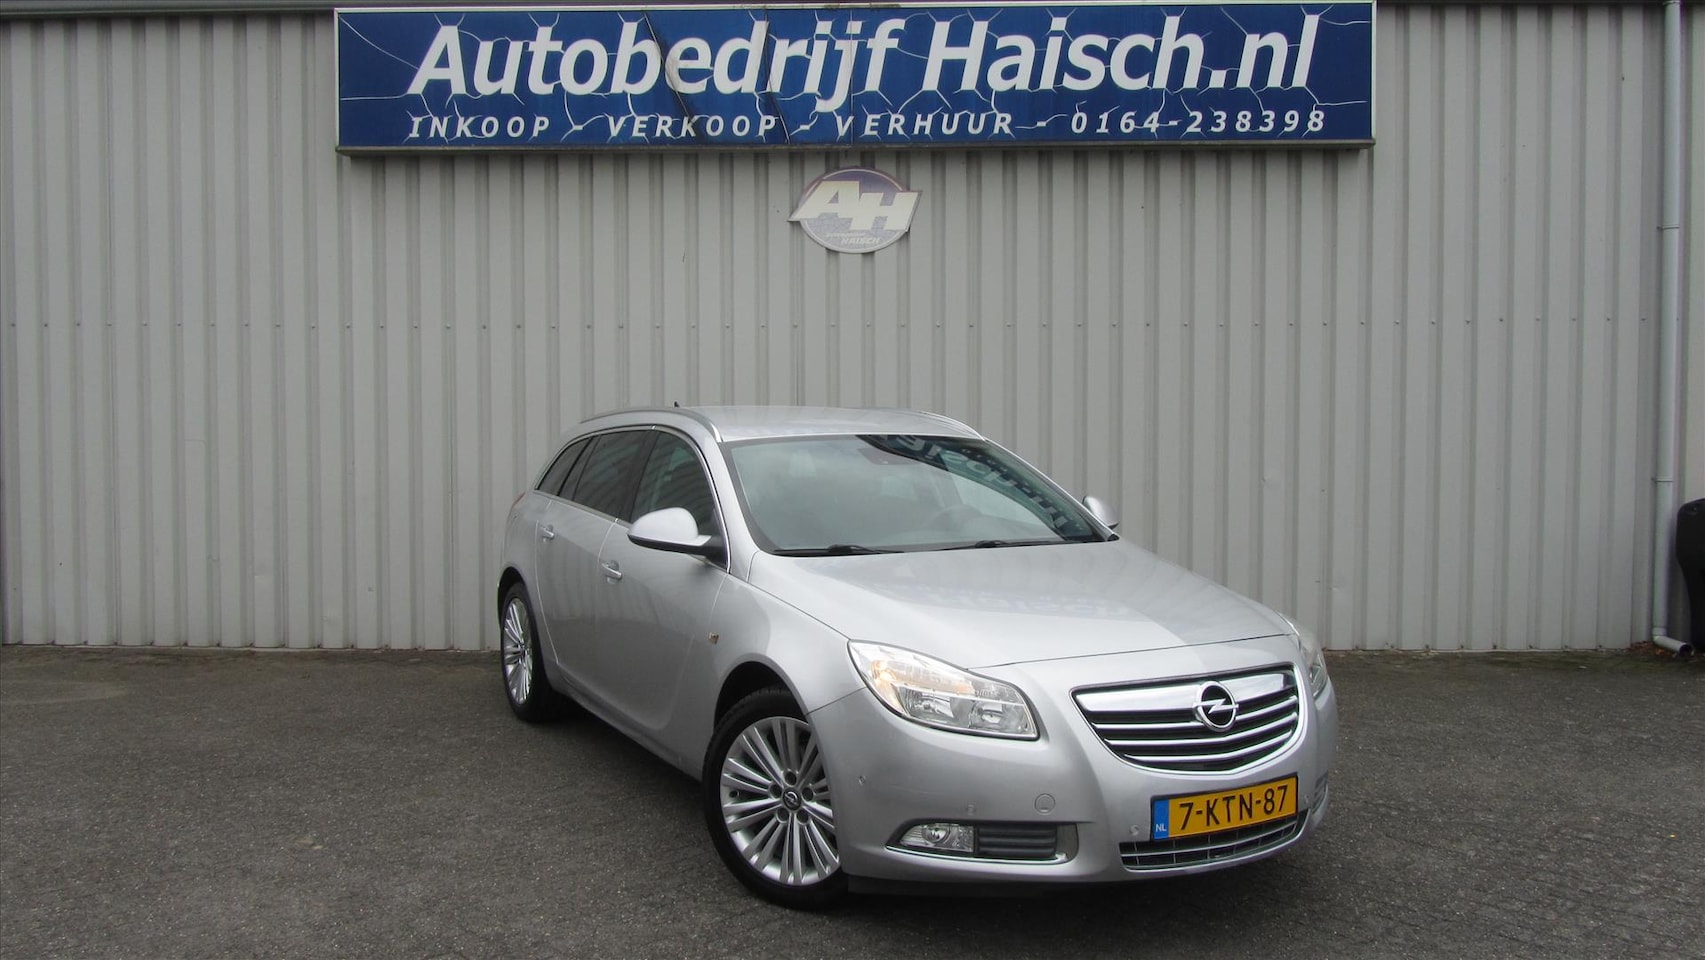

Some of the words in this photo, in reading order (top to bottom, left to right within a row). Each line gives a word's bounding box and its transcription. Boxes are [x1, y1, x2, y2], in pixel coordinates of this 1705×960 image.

[407, 20, 906, 113] Autobedrijf
[922, 14, 1320, 91] Haisch.nl
[408, 115, 551, 138] INKOOP
[608, 114, 778, 138] VERKOOP
[835, 112, 1012, 137] VERHUUR
[1071, 109, 1325, 134] 0164-238398
[789, 180, 919, 231] AH
[1155, 823, 1167, 832] NL
[1179, 784, 1289, 831] 7-KTN-87
